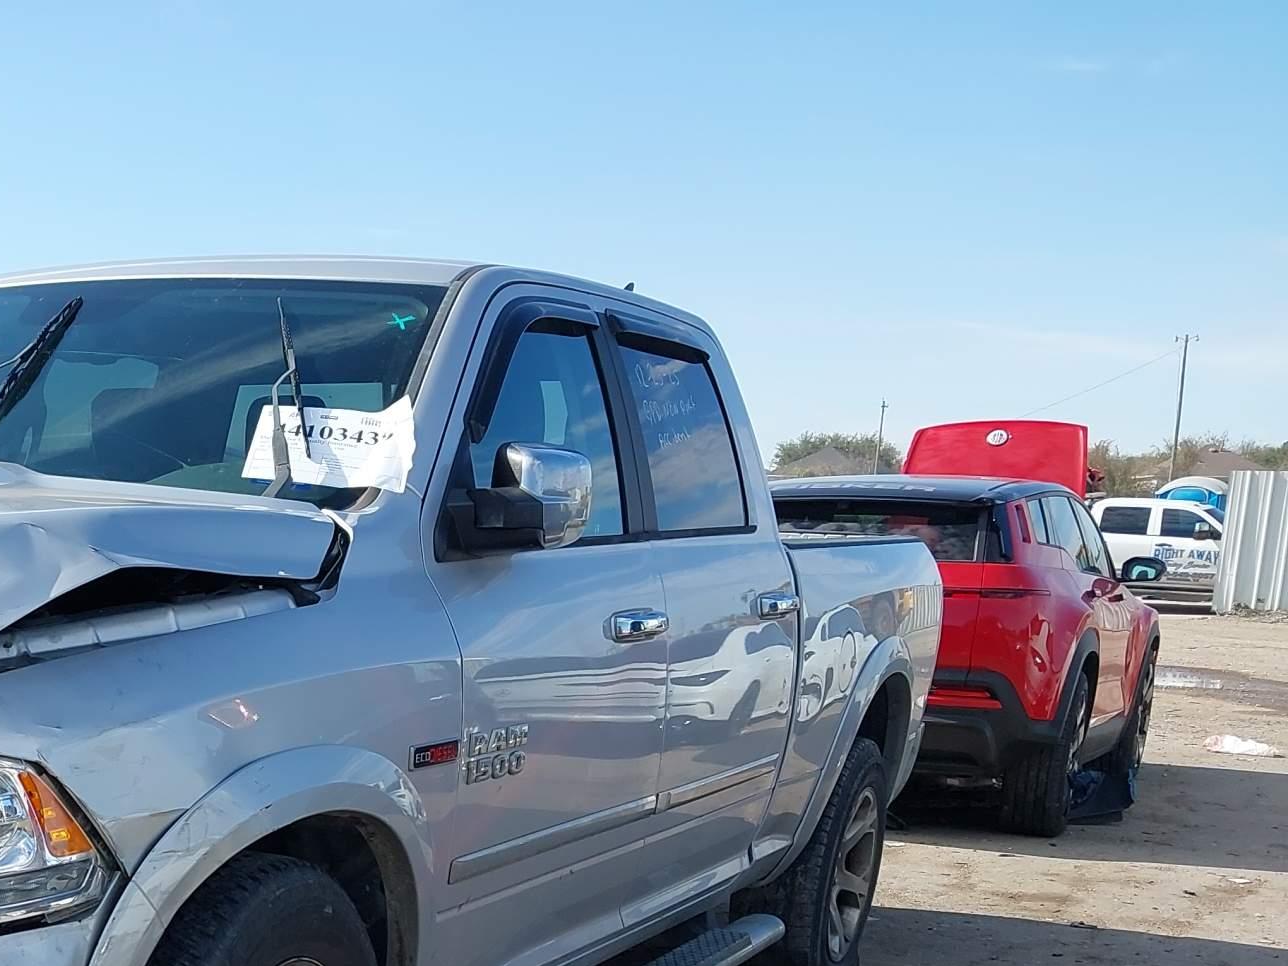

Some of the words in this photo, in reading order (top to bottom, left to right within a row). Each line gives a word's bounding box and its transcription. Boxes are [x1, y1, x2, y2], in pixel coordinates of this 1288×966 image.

[1154, 548, 1185, 560] RIGHT
[1188, 549, 1220, 565] AWAY
[469, 723, 529, 757] RAM
[466, 750, 526, 785] 1500
